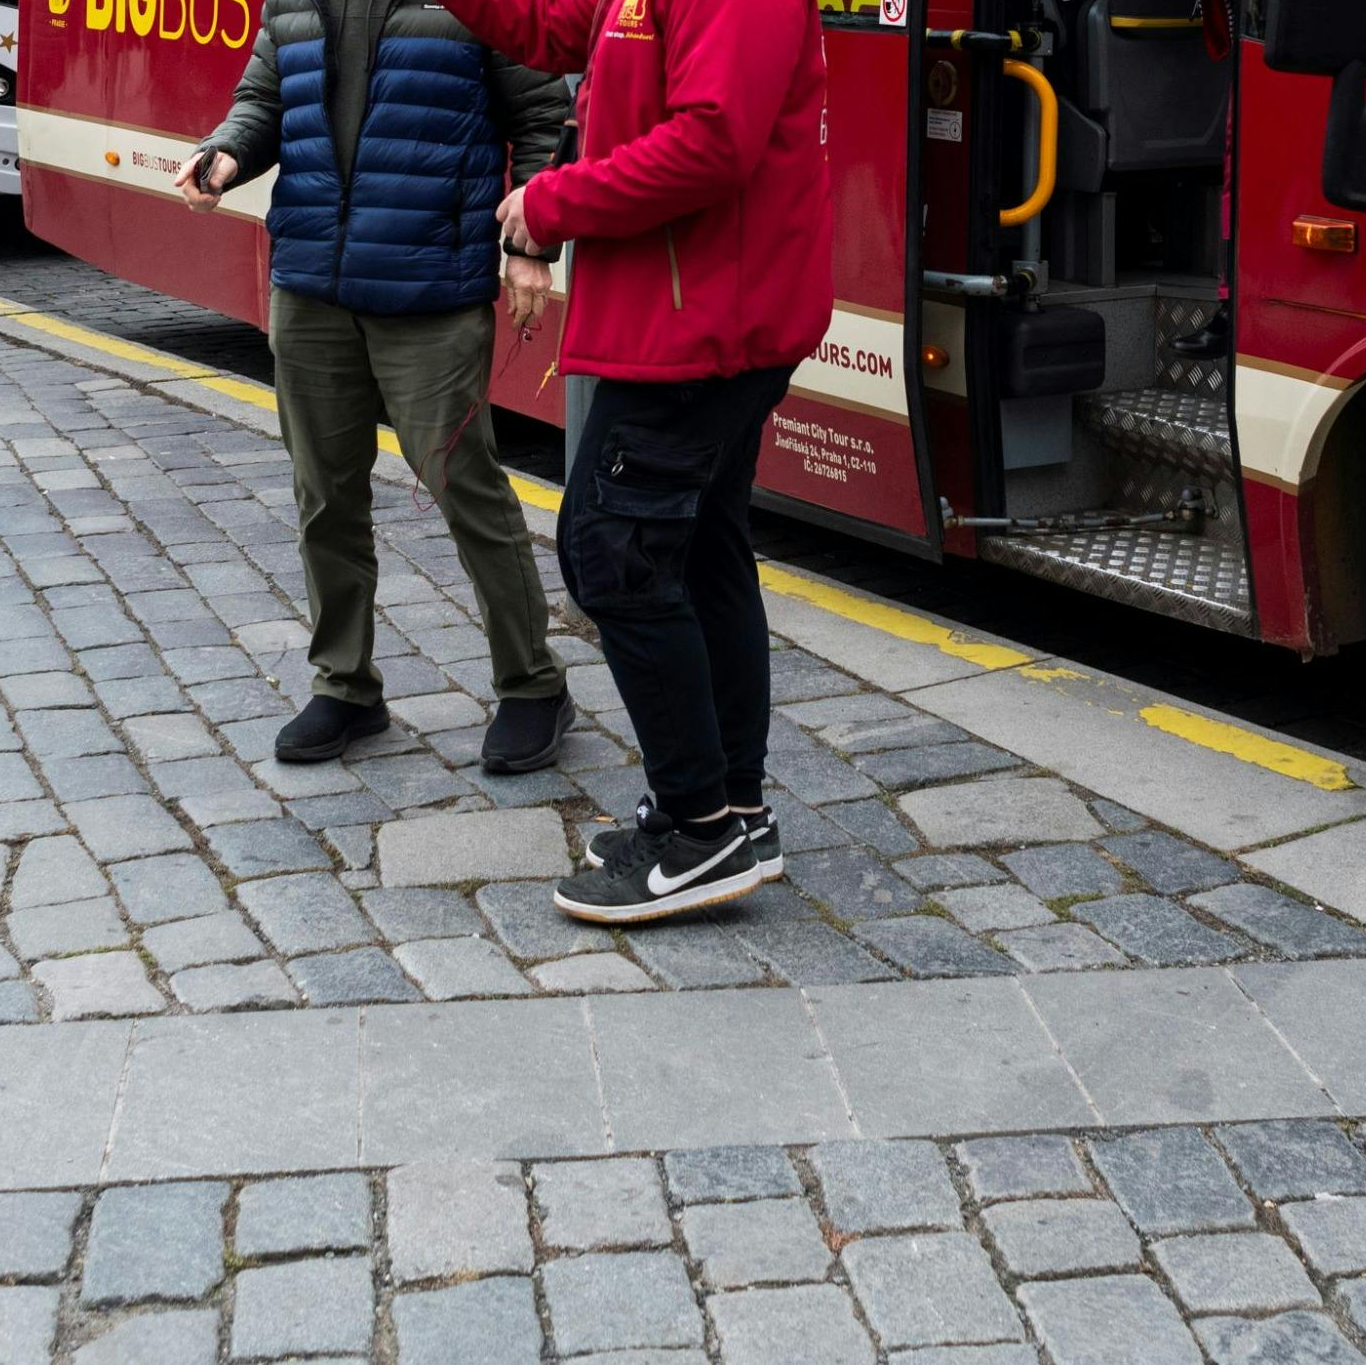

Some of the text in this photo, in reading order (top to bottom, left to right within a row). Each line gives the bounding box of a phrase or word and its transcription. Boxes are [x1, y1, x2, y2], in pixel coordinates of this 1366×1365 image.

[773, 411, 875, 454] Premiant City Tour s.r.o.
[821, 448, 842, 464] Praha
[850, 456, 877, 475] CZ-110
